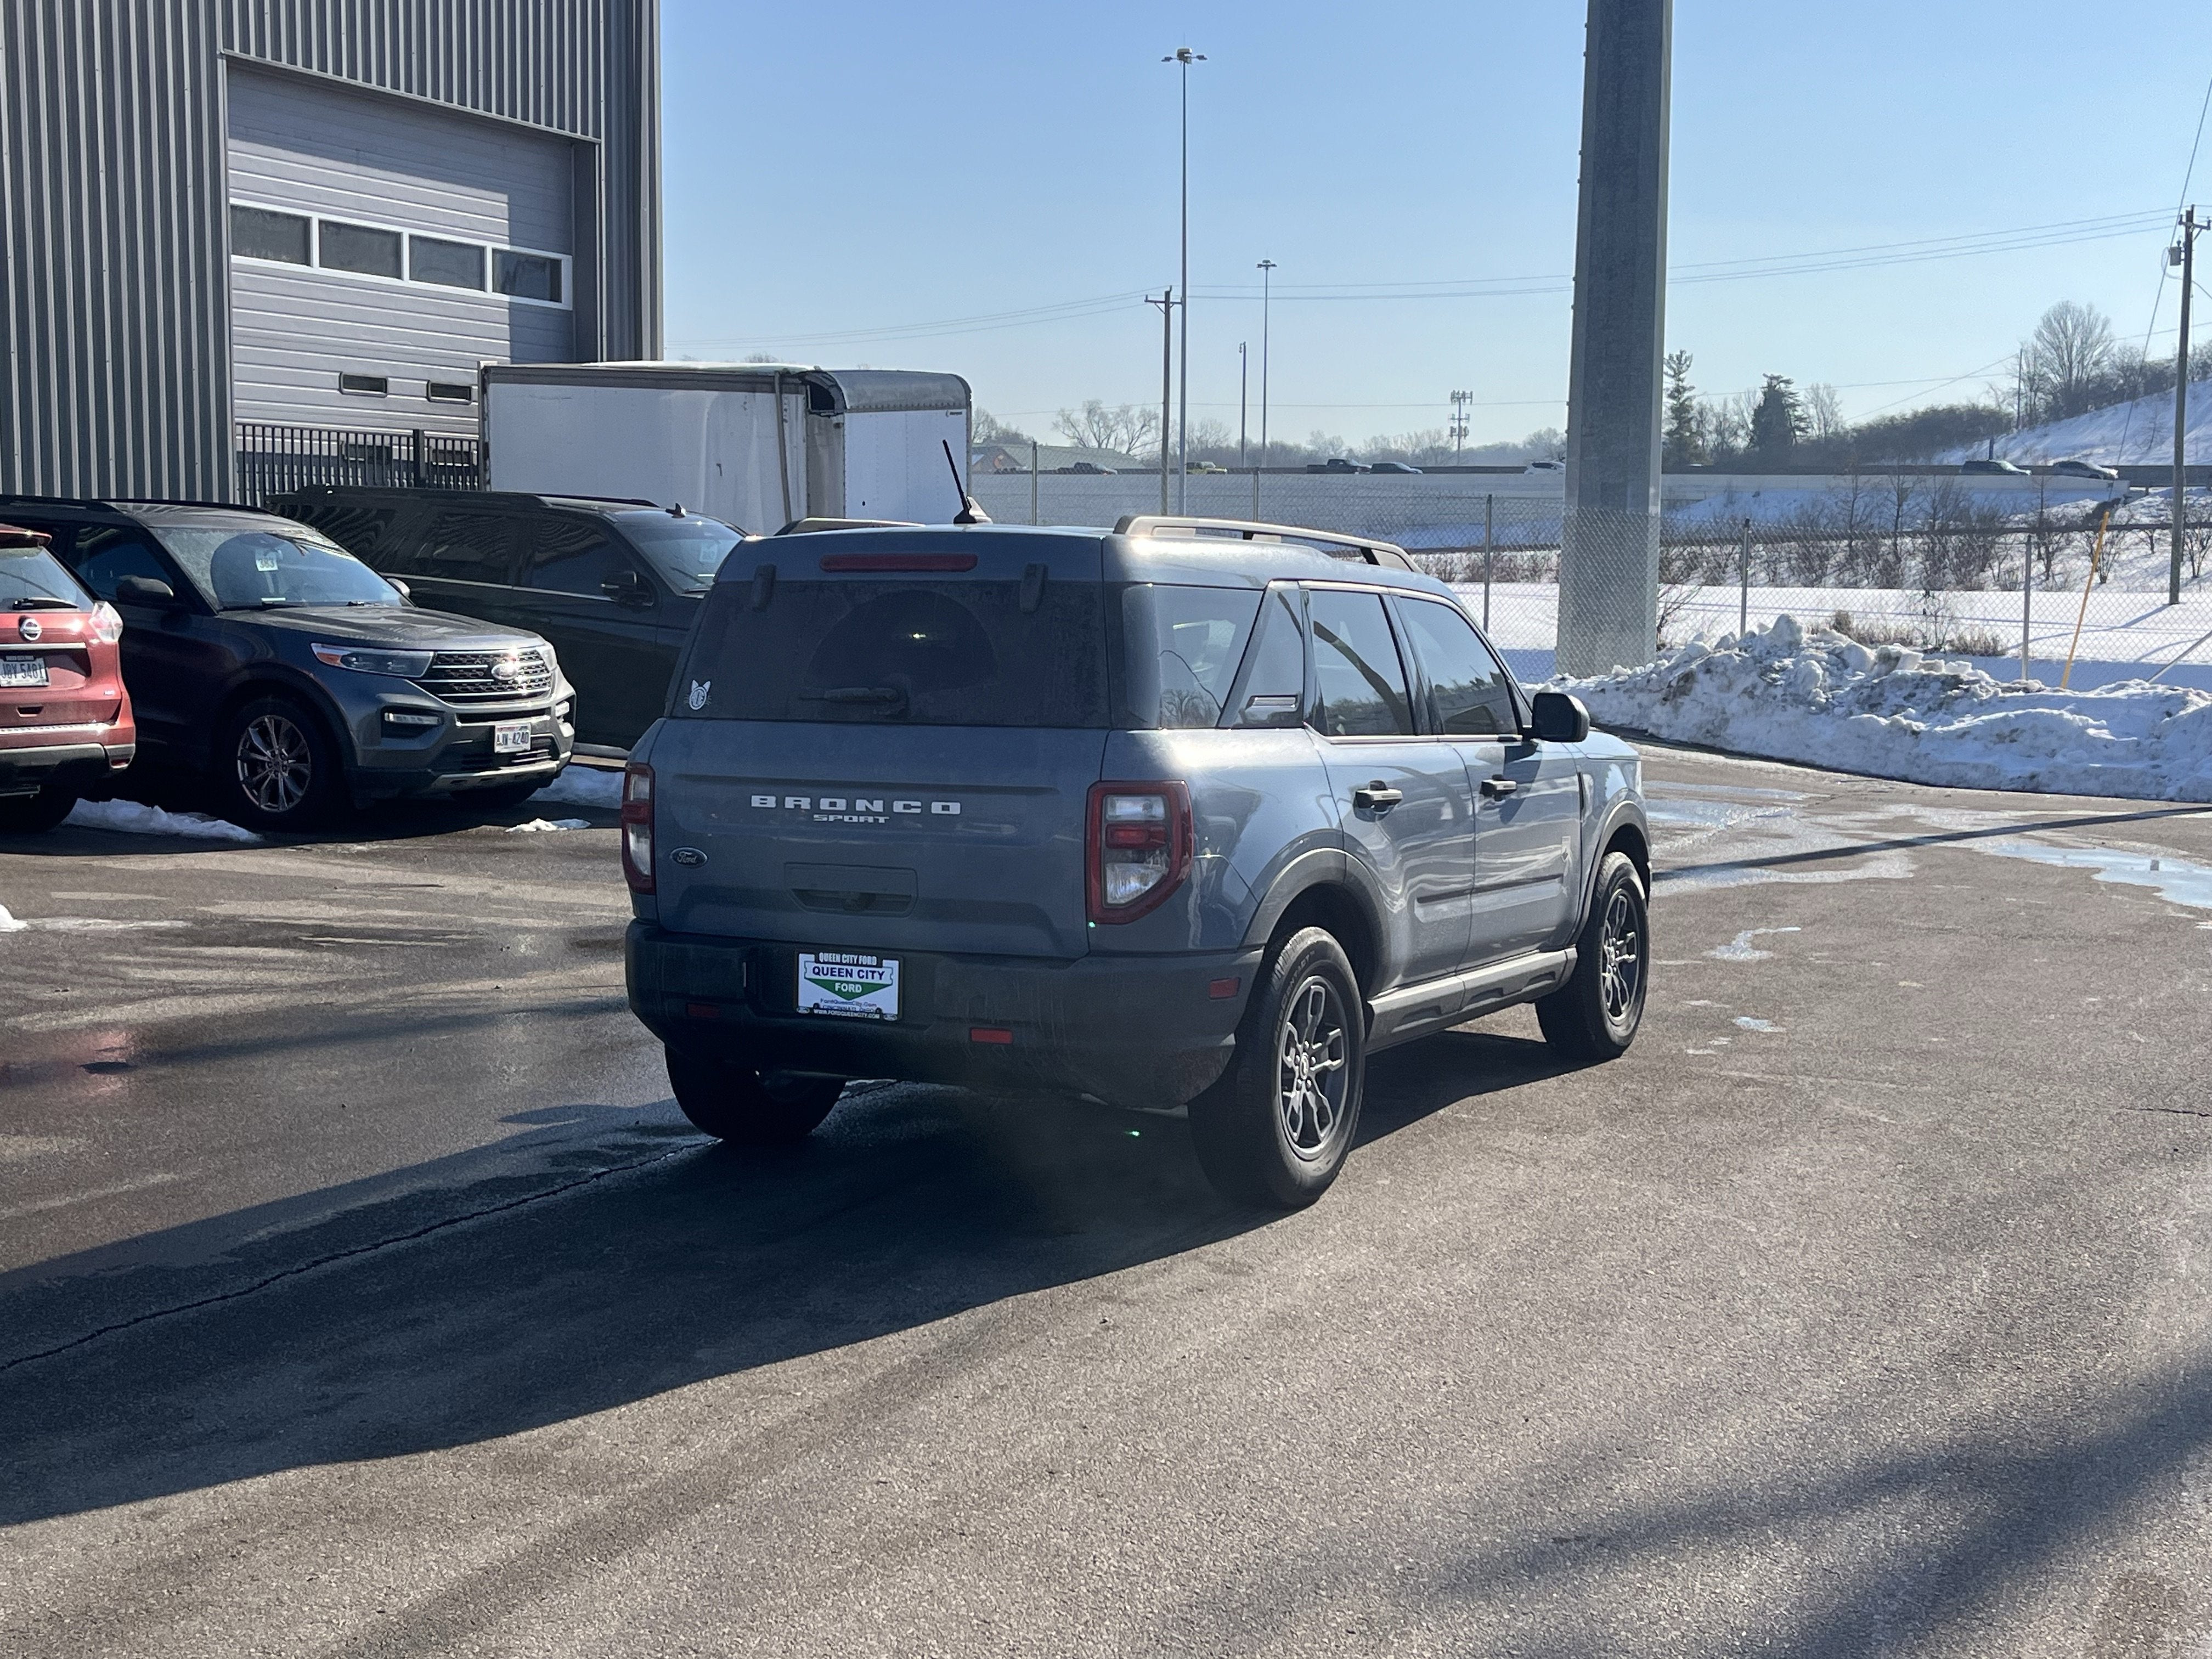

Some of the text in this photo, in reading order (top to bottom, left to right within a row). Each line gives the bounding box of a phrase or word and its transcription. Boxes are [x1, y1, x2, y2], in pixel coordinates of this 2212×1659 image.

[751, 795, 961, 815] BRONCO
[813, 814, 890, 823] SPORT
[677, 851, 697, 863] Ford
[819, 952, 877, 966] QUEEN CITY FORD
[812, 966, 885, 980] QUEEN CITY
[835, 983, 862, 993] FORD
